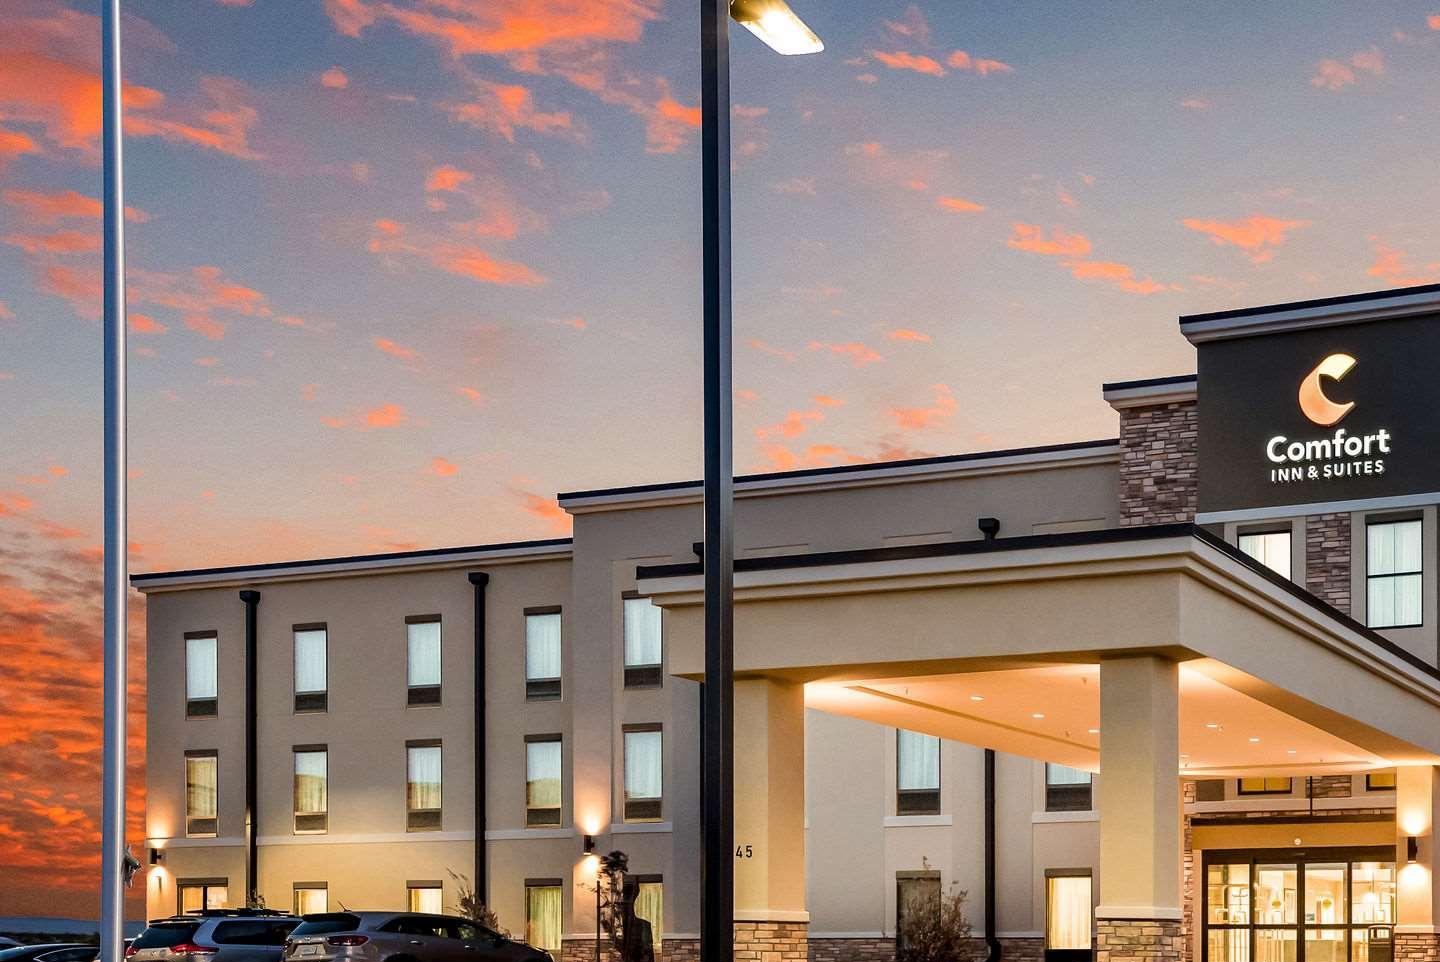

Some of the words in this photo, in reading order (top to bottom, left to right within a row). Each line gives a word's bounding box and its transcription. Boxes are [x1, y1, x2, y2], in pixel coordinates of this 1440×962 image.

[1266, 428, 1391, 463] Comfort
[1271, 467, 1302, 482] INN
[1307, 466, 1319, 478] &
[1323, 460, 1384, 477] SUITES
